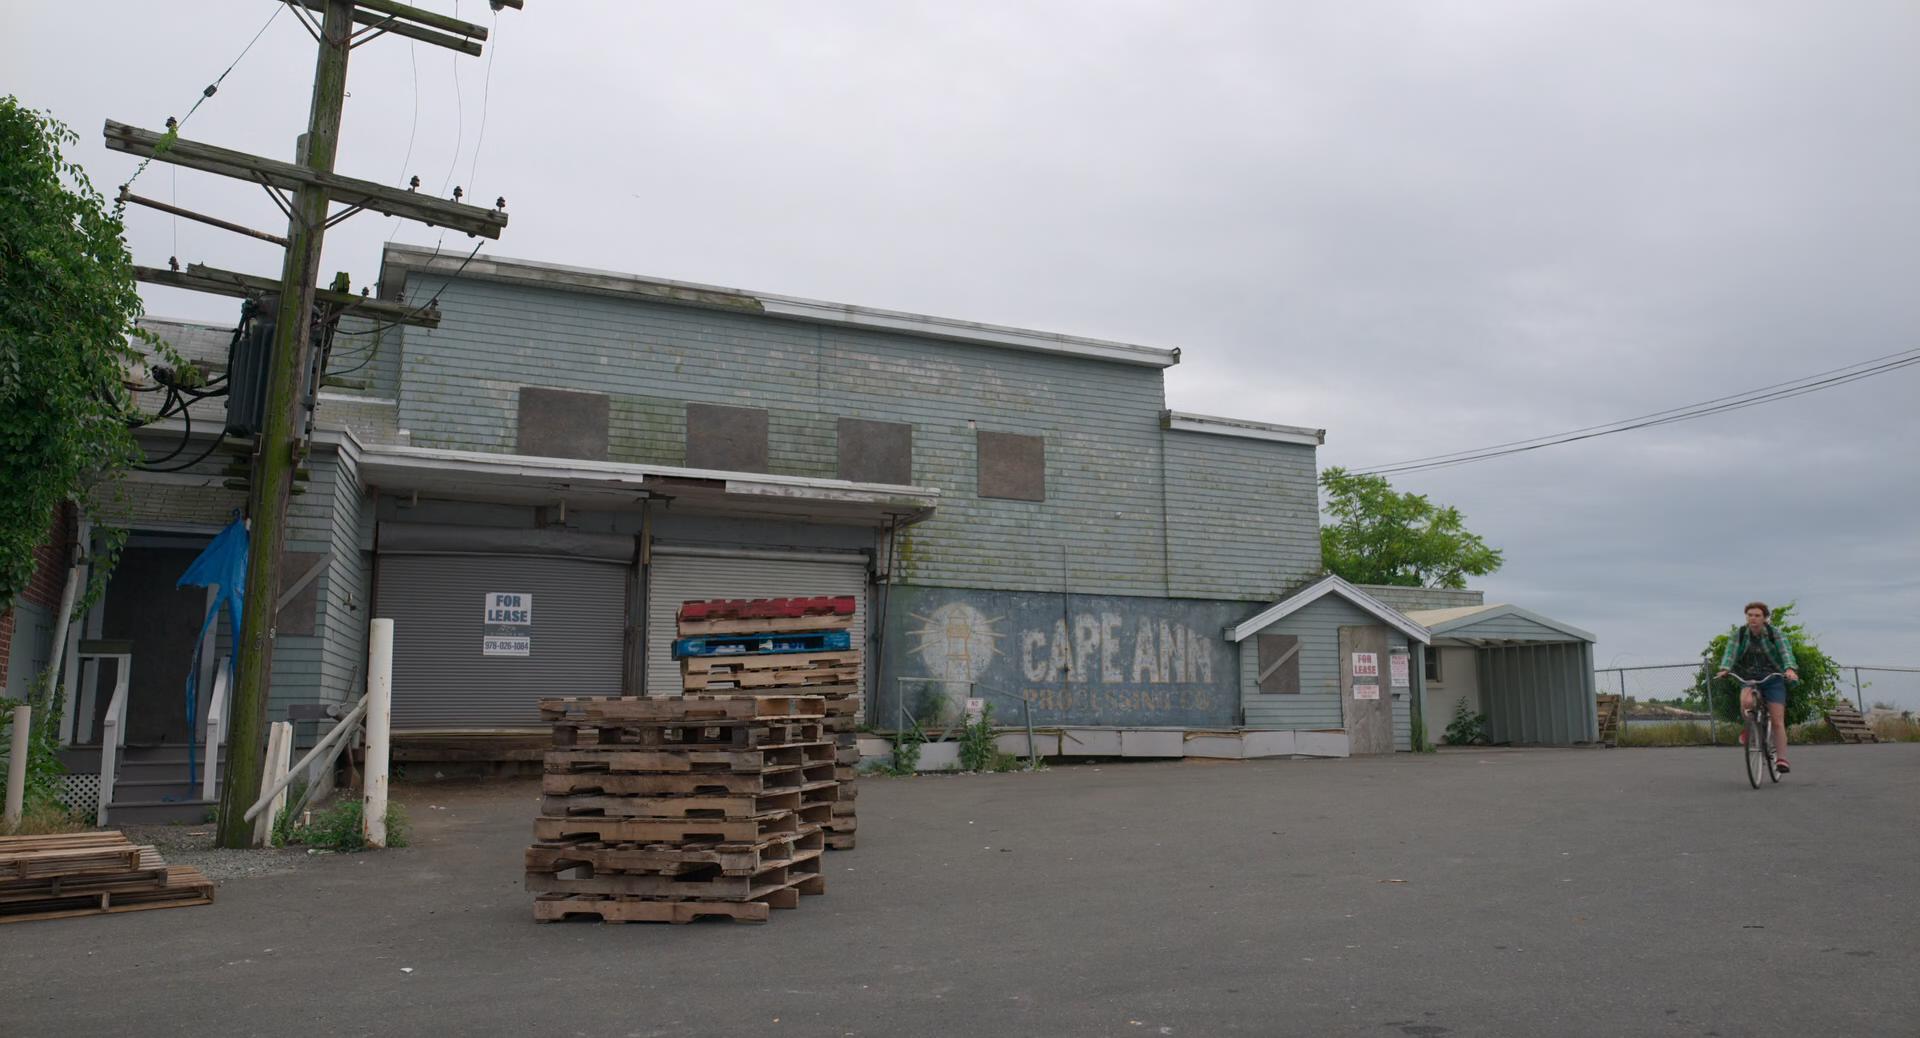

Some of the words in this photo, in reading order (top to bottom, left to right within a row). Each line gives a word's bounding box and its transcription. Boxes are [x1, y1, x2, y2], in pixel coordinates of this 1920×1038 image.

[496, 594, 521, 607] FOR
[488, 610, 528, 622] LEASE
[1022, 612, 1124, 683] CAPE
[1132, 615, 1212, 684] ANN
[1358, 654, 1372, 663] FOR
[1354, 665, 1376, 674] LEASE
